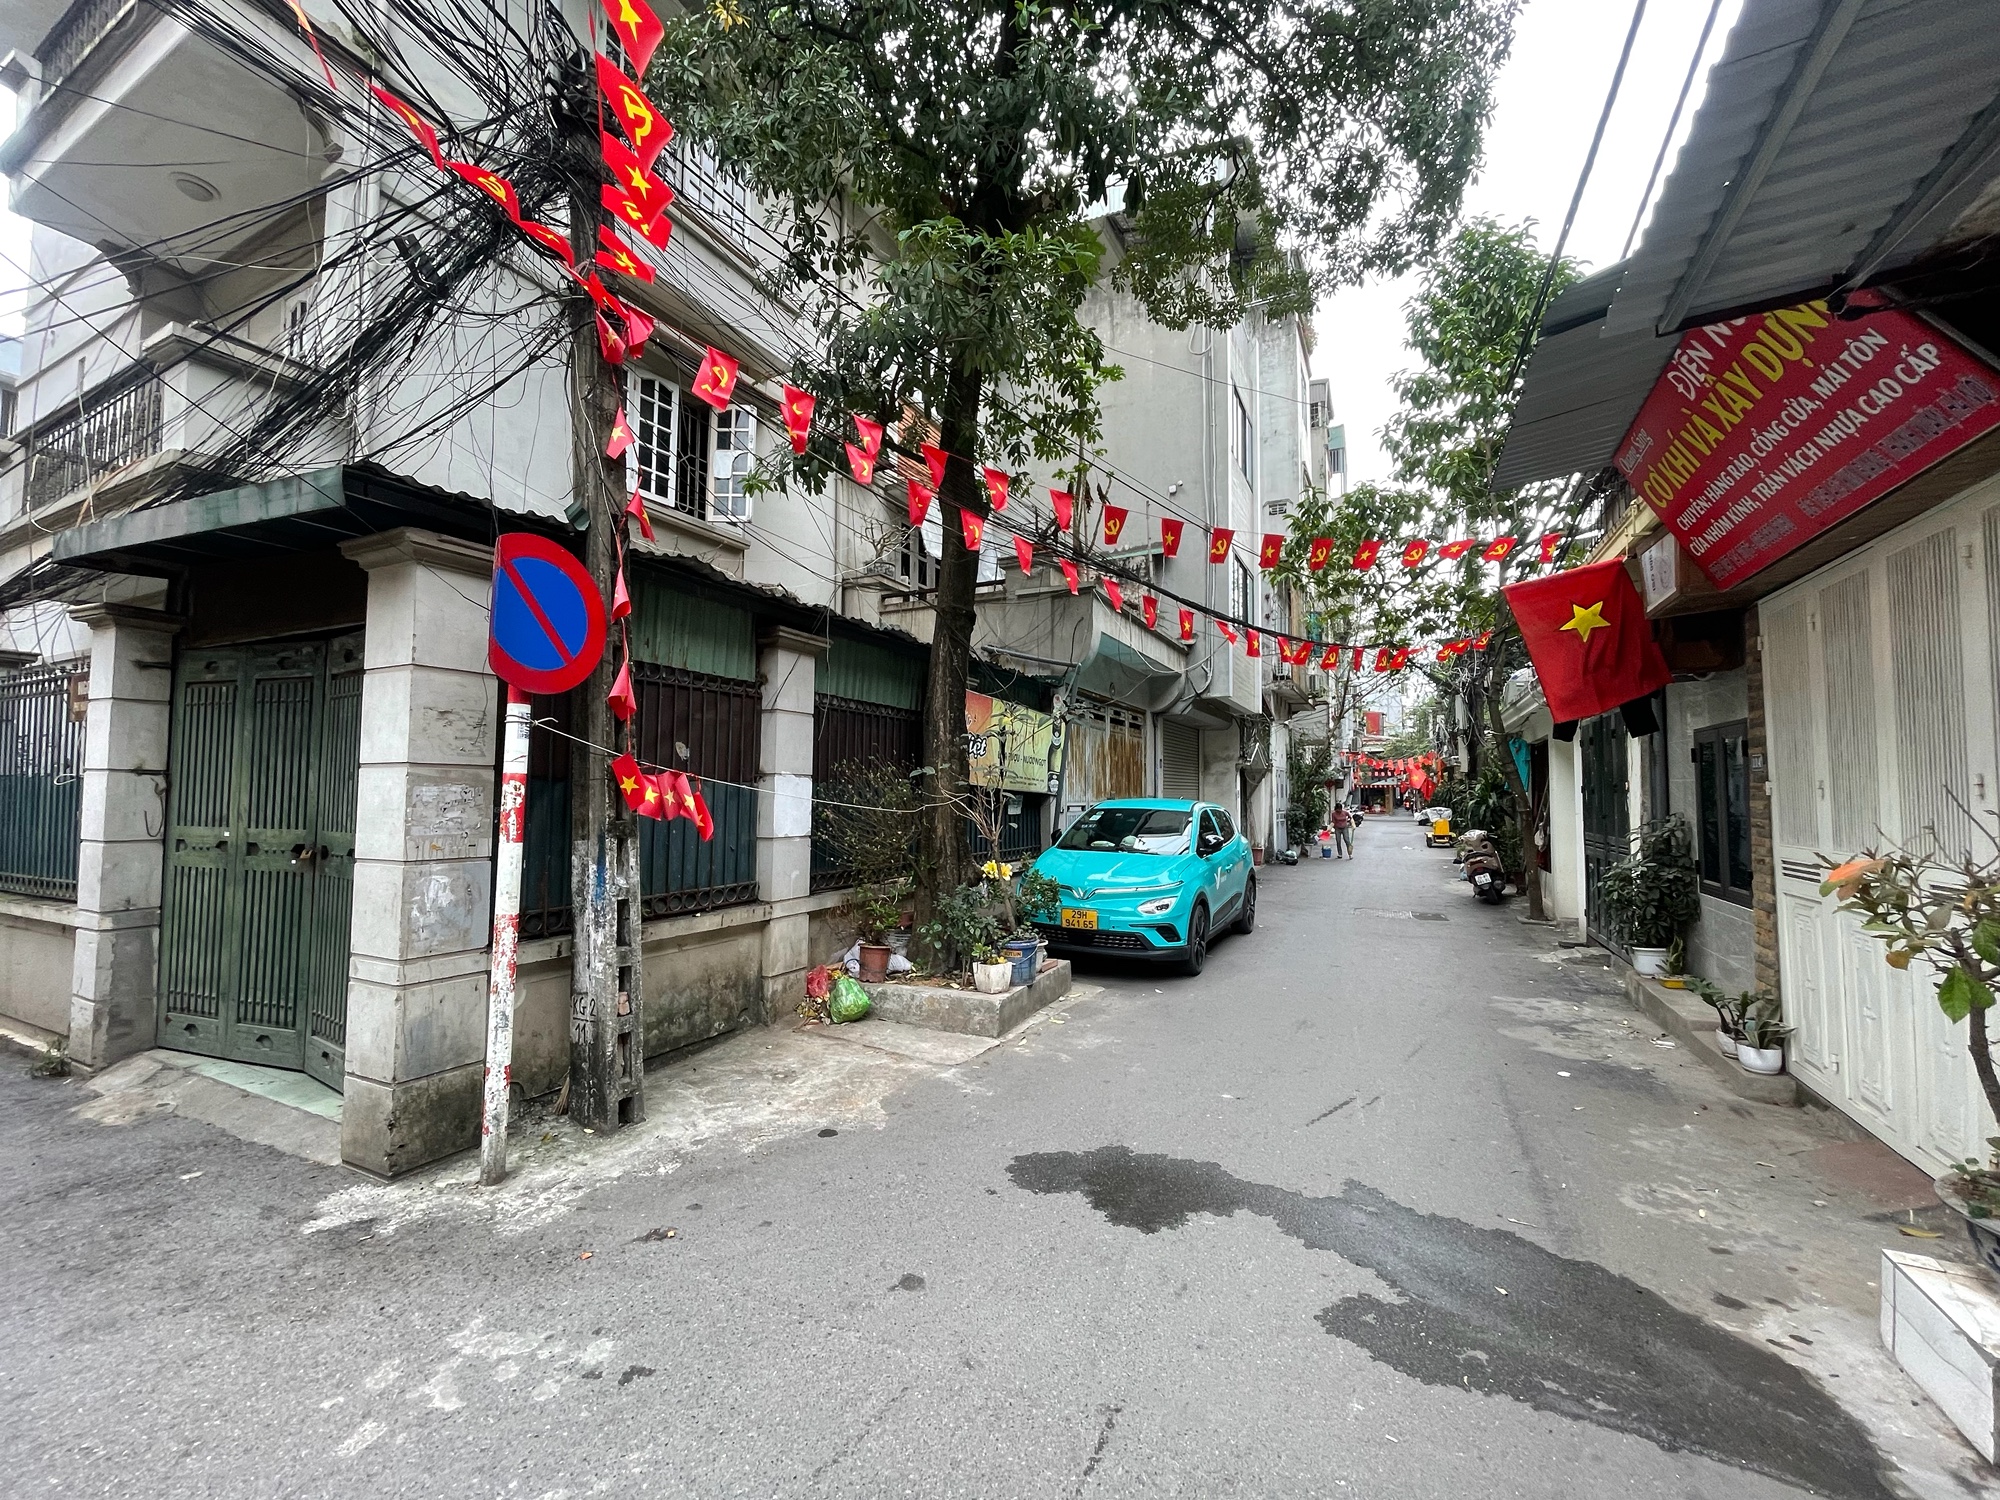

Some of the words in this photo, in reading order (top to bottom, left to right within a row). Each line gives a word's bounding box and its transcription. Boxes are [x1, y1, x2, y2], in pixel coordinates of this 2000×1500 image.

[1701, 361, 1764, 433] XÂY
[1676, 496, 1713, 531] CHUYÊN:
[1704, 471, 1735, 502] HÀNG
[1727, 452, 1762, 481] RÀO,
[1750, 420, 1790, 458] CỔNG
[1781, 396, 1825, 428] CỬA,
[1809, 362, 1852, 400] MÁI
[1839, 327, 1889, 370] TÔN
[1680, 407, 1726, 456] VÀ
[1689, 535, 1711, 557] CỬA
[1704, 515, 1735, 546] NHÔM
[1726, 495, 1764, 529] KÍNH,
[1751, 470, 1790, 502] TRẦN
[1779, 441, 1824, 478] VÁCH
[1813, 408, 1869, 452] NHỰA
[1857, 377, 1903, 415] CAO
[1894, 342, 1942, 384] CẤP
[1643, 464, 1674, 508] CƠ
[1657, 428, 1701, 490] KHÍ
[968, 734, 987, 758] iệt
[1071, 910, 1088, 919] 29H
